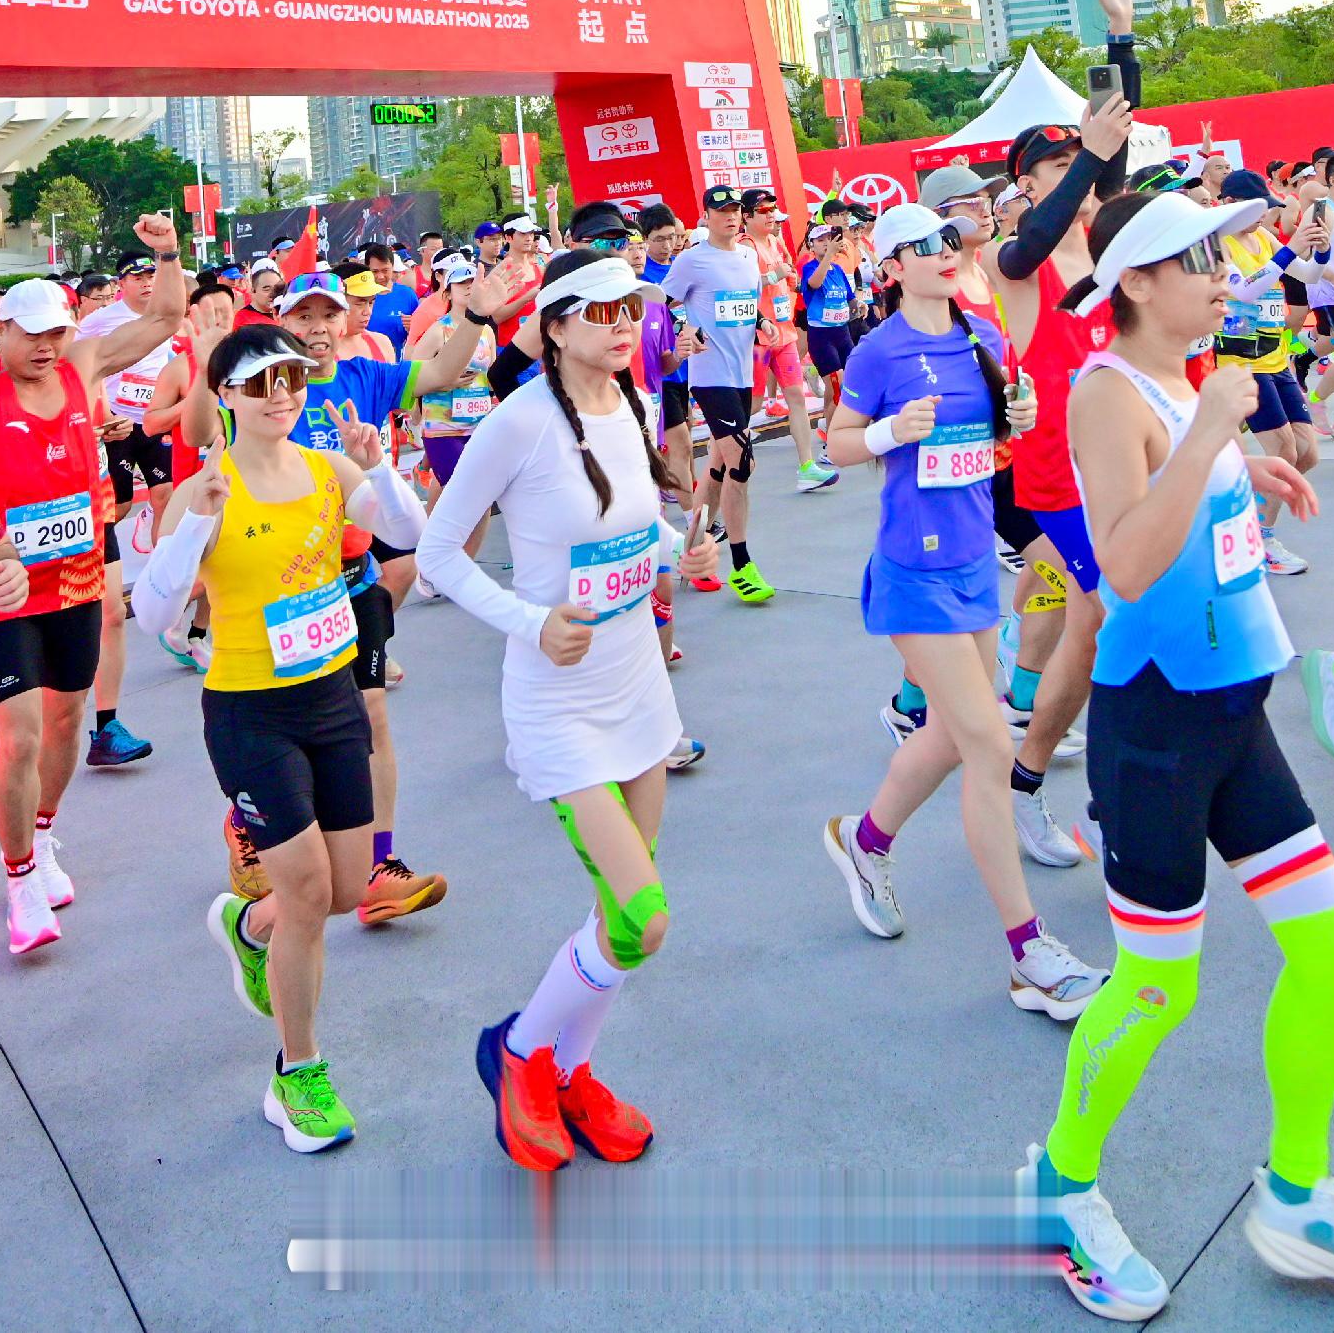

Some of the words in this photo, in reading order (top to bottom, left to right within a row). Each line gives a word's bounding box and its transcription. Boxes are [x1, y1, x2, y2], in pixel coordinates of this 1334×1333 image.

[273, 1, 393, 24] GUANGZHOU
[396, 8, 492, 28] MARATHON
[494, 12, 530, 29] 2025
[598, 140, 650, 158] 广汽丰田
[720, 305, 726, 314] D
[732, 303, 755, 317] 1540
[776, 306, 782, 314] D
[455, 402, 462, 410] D
[926, 454, 939, 470] D
[950, 448, 992, 478] 8882
[14, 531, 25, 544] D
[37, 516, 87, 547] 2900
[1222, 534, 1234, 555] D
[578, 578, 592, 596] D
[606, 556, 651, 601] 9548
[278, 633, 293, 652] D
[306, 605, 350, 650] 9355
